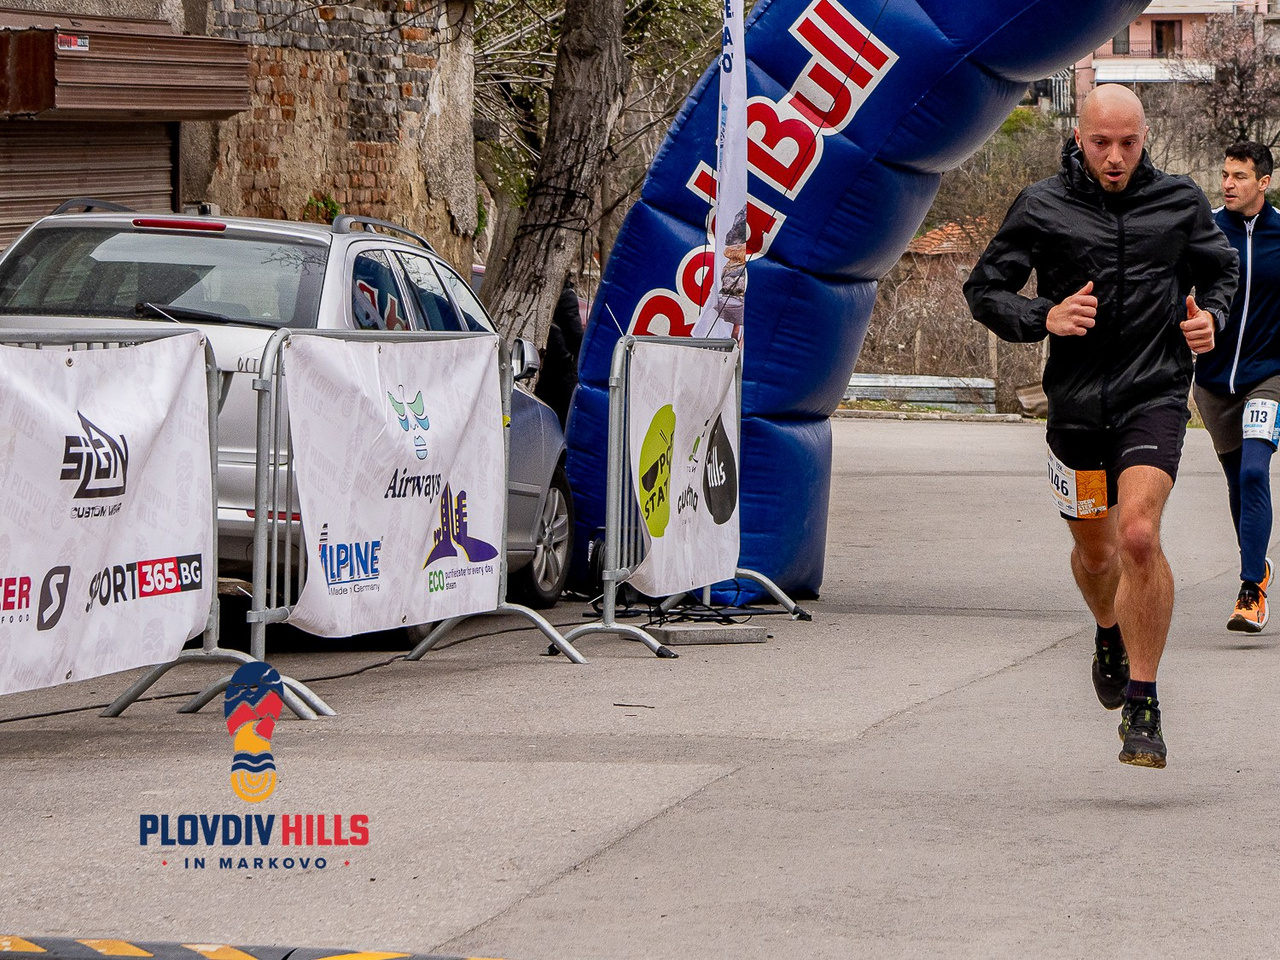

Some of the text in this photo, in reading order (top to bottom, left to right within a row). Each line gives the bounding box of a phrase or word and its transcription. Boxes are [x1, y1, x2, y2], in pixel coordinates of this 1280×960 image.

[1250, 410, 1268, 423] 113
[384, 468, 442, 504] Airways
[428, 570, 445, 592] ECO
[0, 576, 31, 611] ER
[1, 613, 30, 624] FOOD
